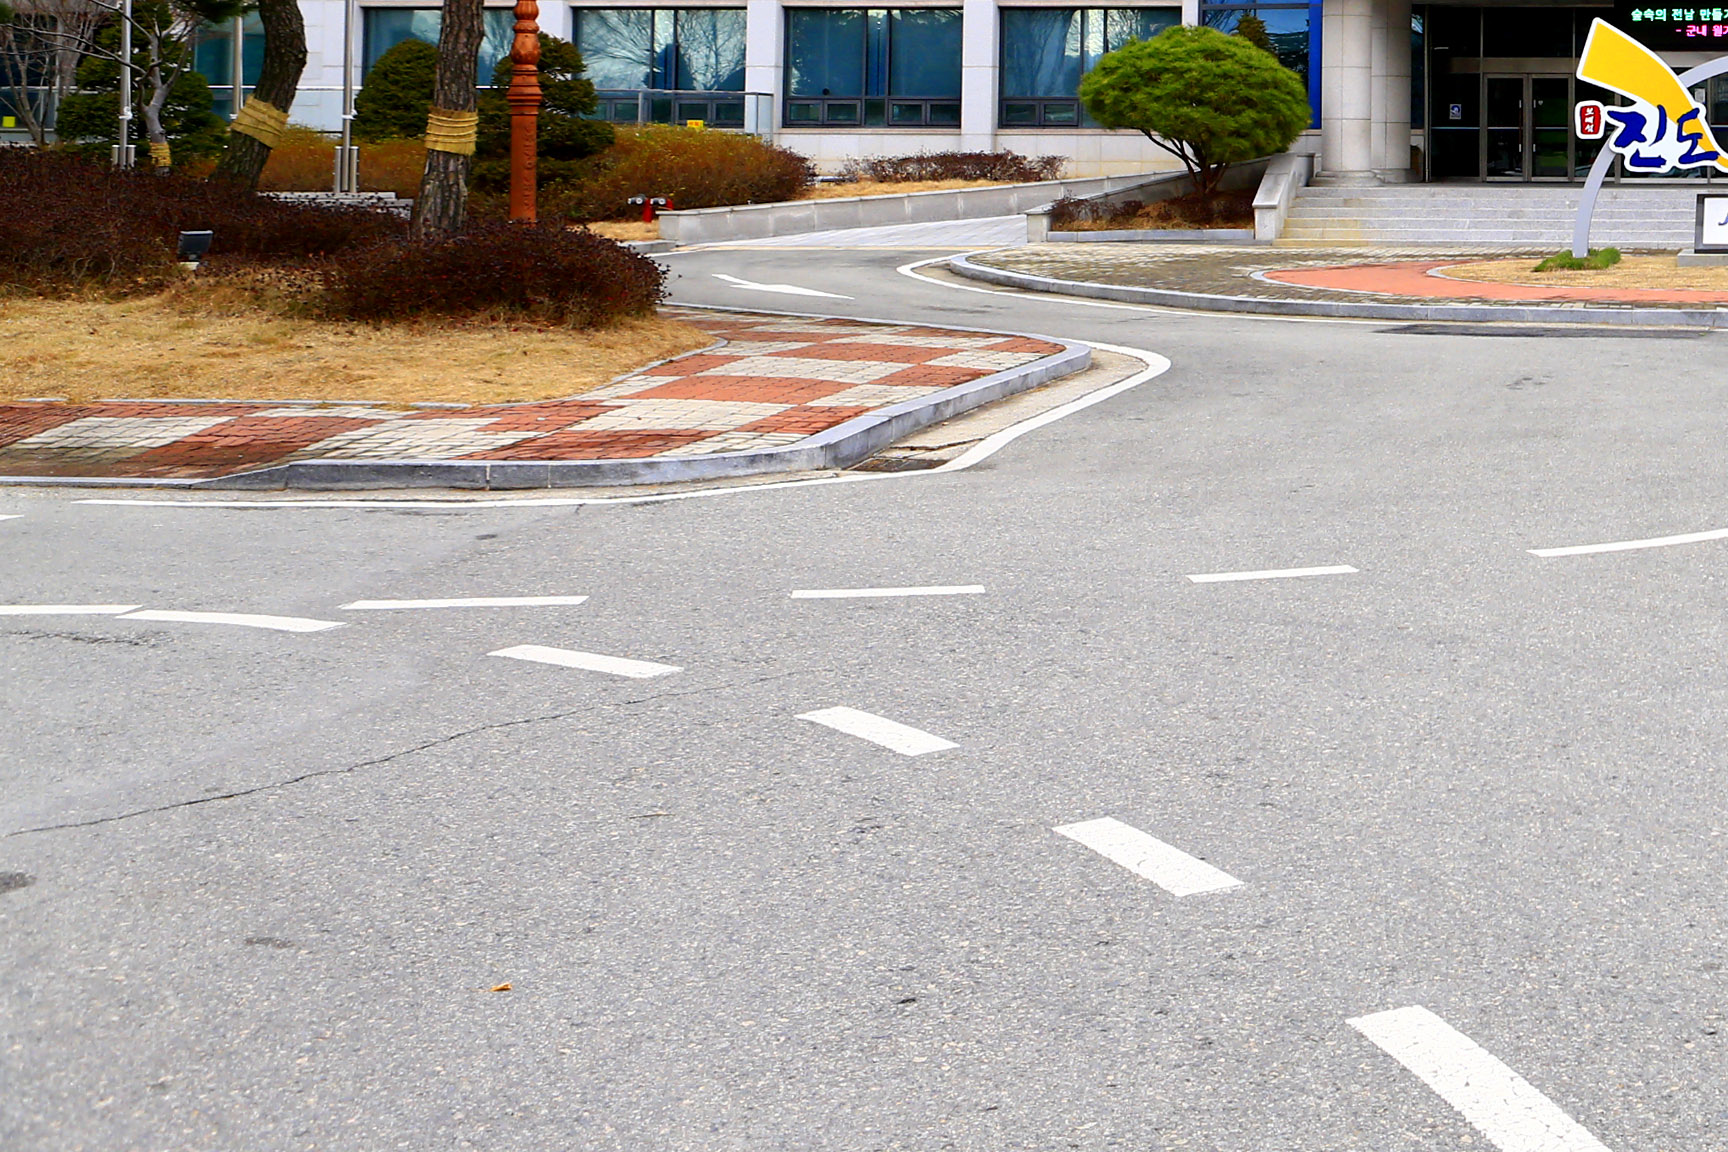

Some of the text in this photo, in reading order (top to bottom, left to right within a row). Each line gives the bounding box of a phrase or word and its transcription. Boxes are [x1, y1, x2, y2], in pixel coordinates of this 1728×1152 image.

[1631, 8, 1667, 22] 숲속의
[1671, 8, 1695, 21] 전남
[1685, 25, 1708, 37] 군내
